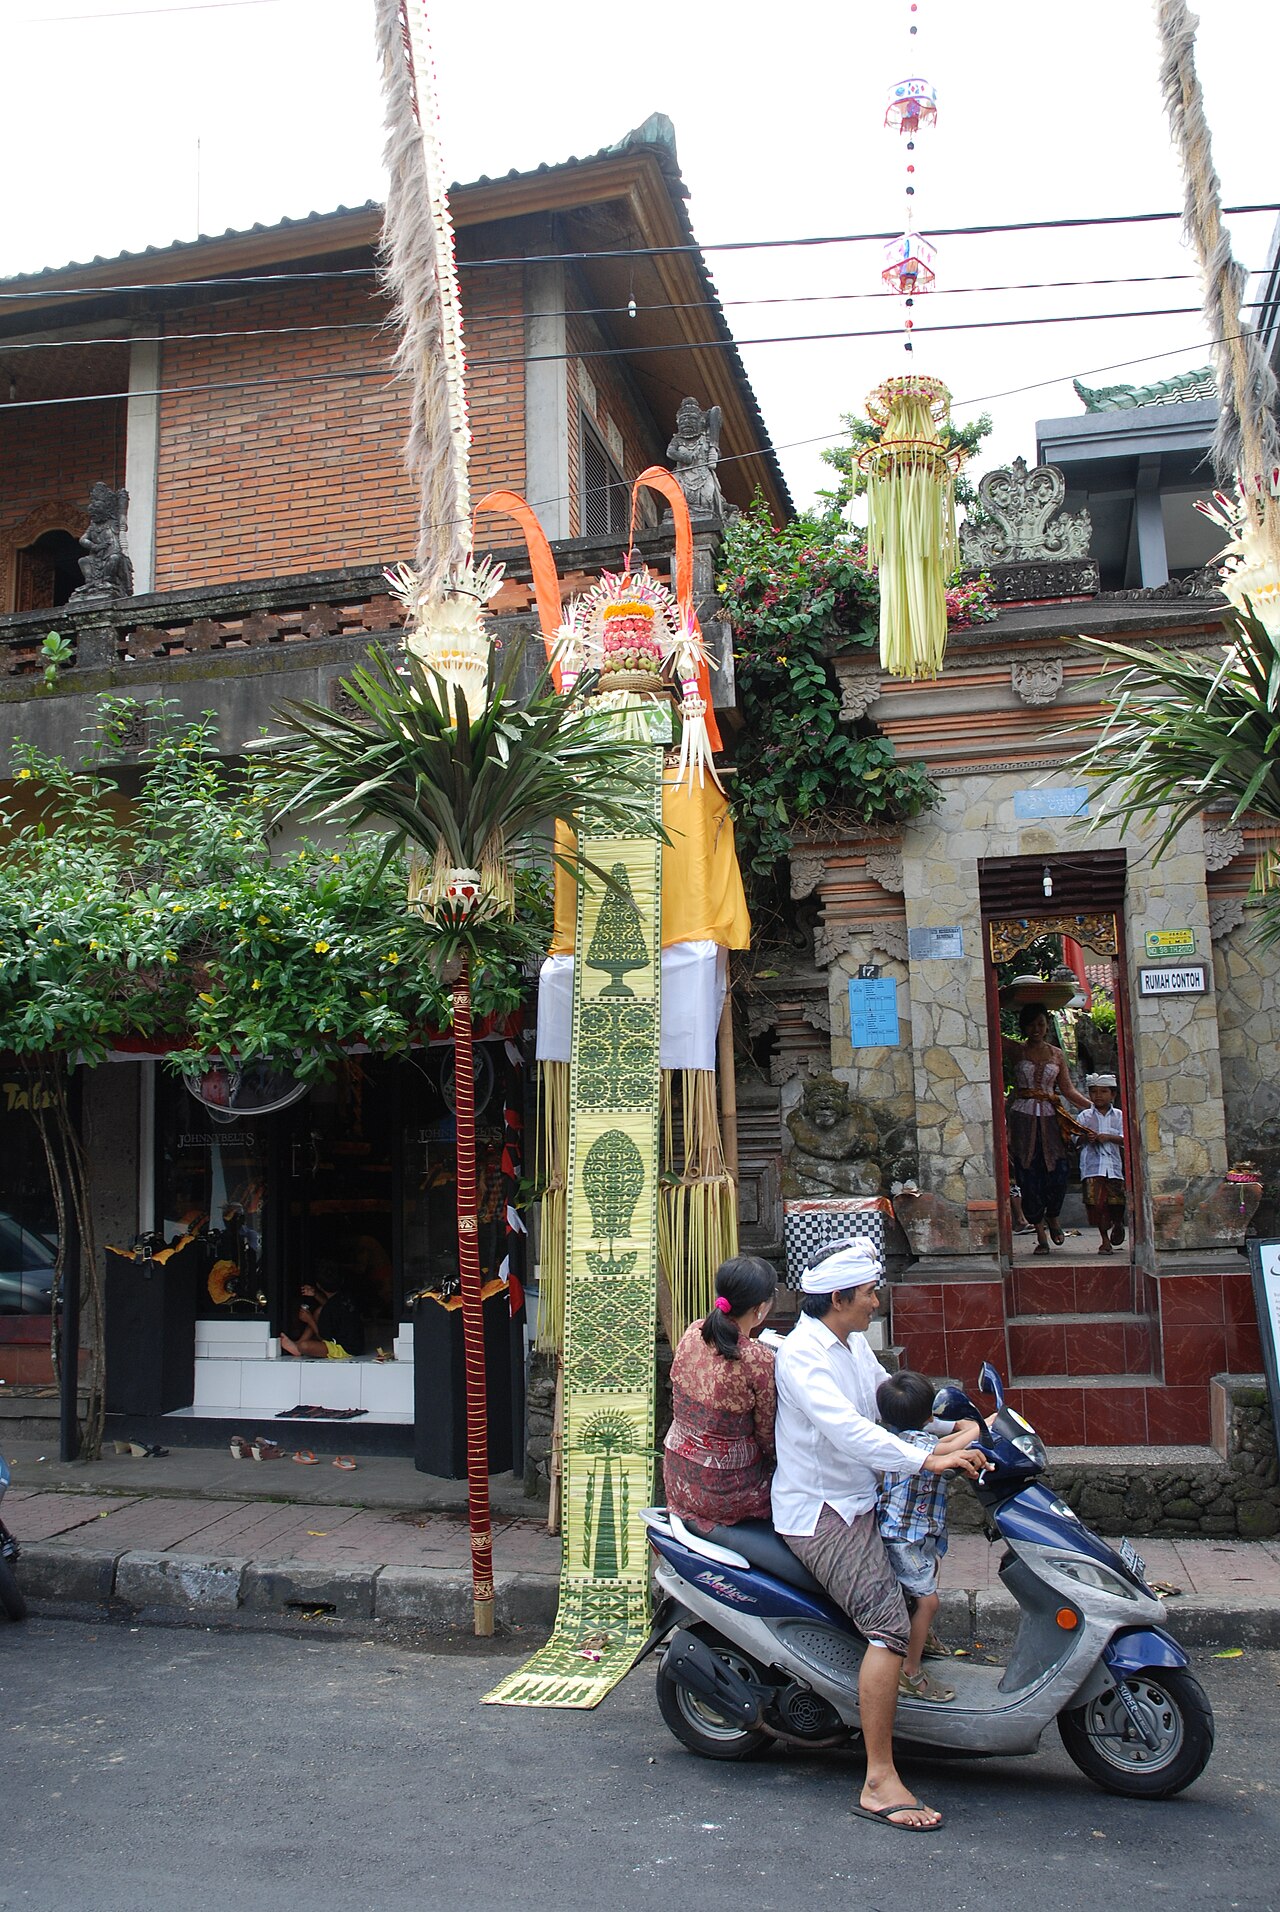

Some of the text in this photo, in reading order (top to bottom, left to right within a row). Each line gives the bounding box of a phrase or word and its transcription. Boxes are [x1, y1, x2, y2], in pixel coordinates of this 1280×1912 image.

[1145, 972, 1200, 989] RUMAH CONTOH
[177, 1132, 255, 1148] JOHNNYBELTS
[1118, 1685, 1138, 1713] SUPER
